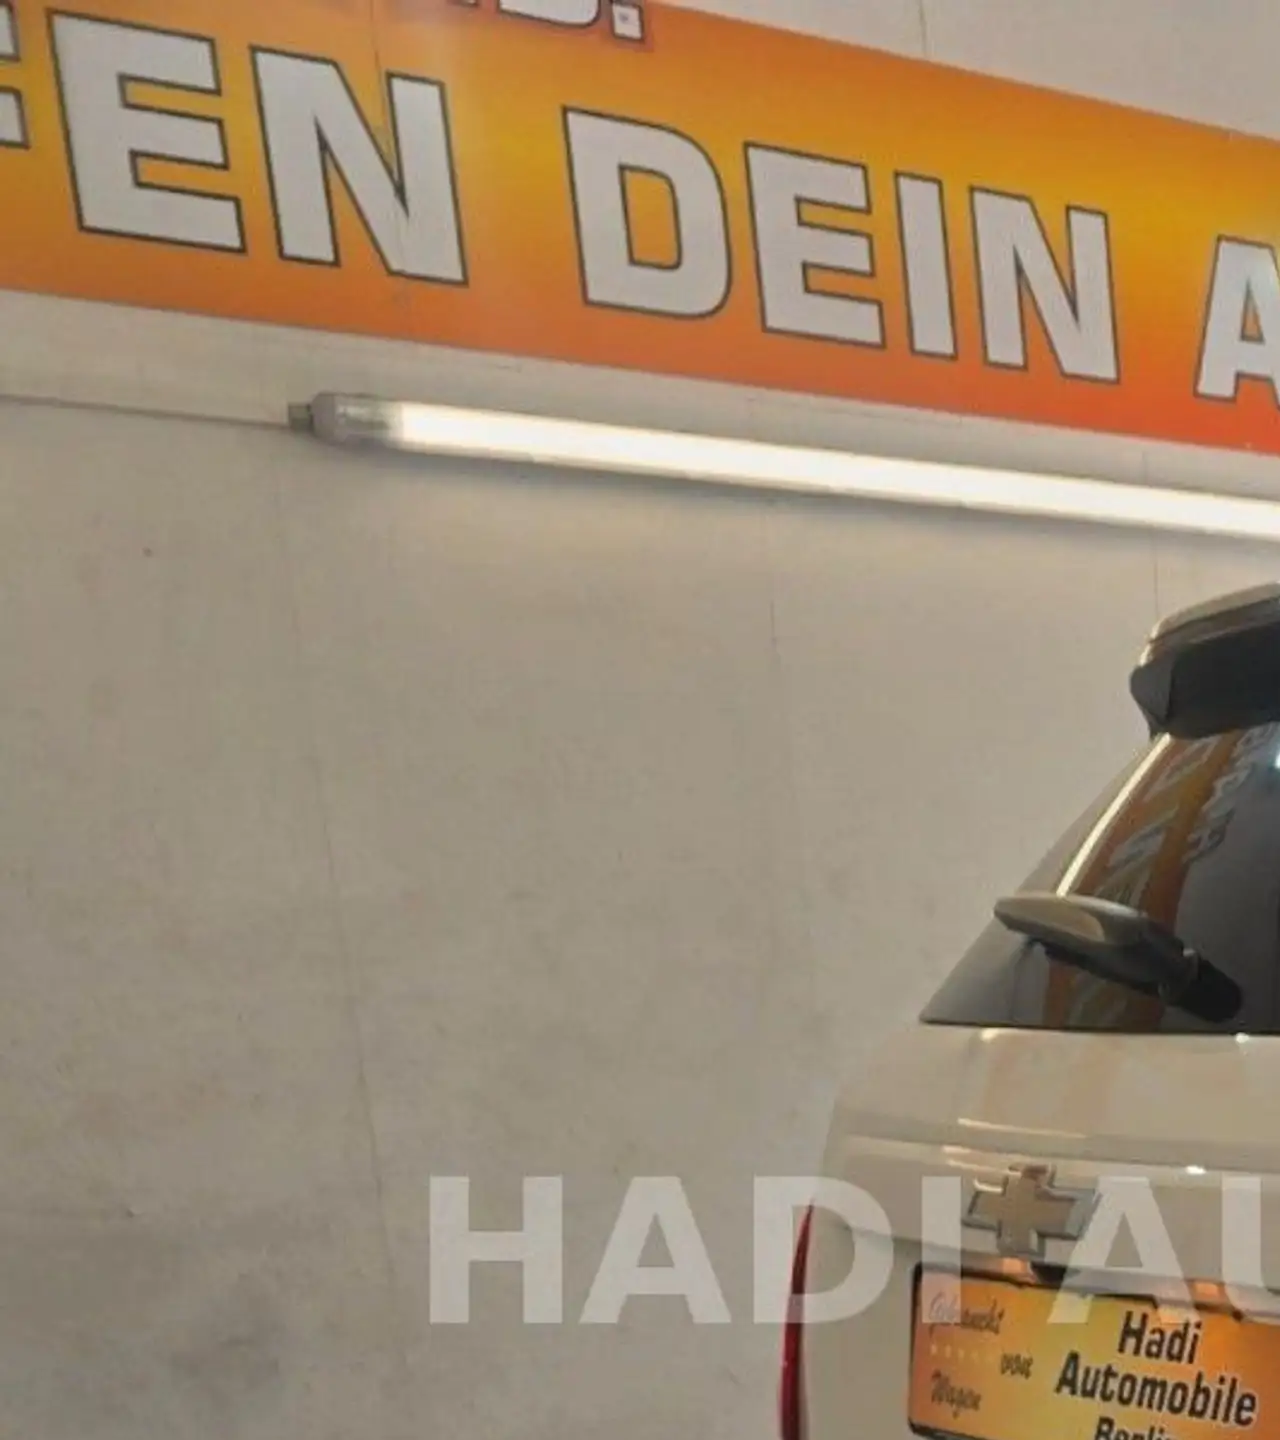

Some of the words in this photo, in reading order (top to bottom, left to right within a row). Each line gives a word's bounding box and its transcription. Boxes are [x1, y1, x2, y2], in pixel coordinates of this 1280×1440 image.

[0, 0, 468, 287] EN
[561, 105, 1120, 383] DEIN
[1117, 1310, 1203, 1365] Hadi
[1054, 1349, 1258, 1427] Automobile
